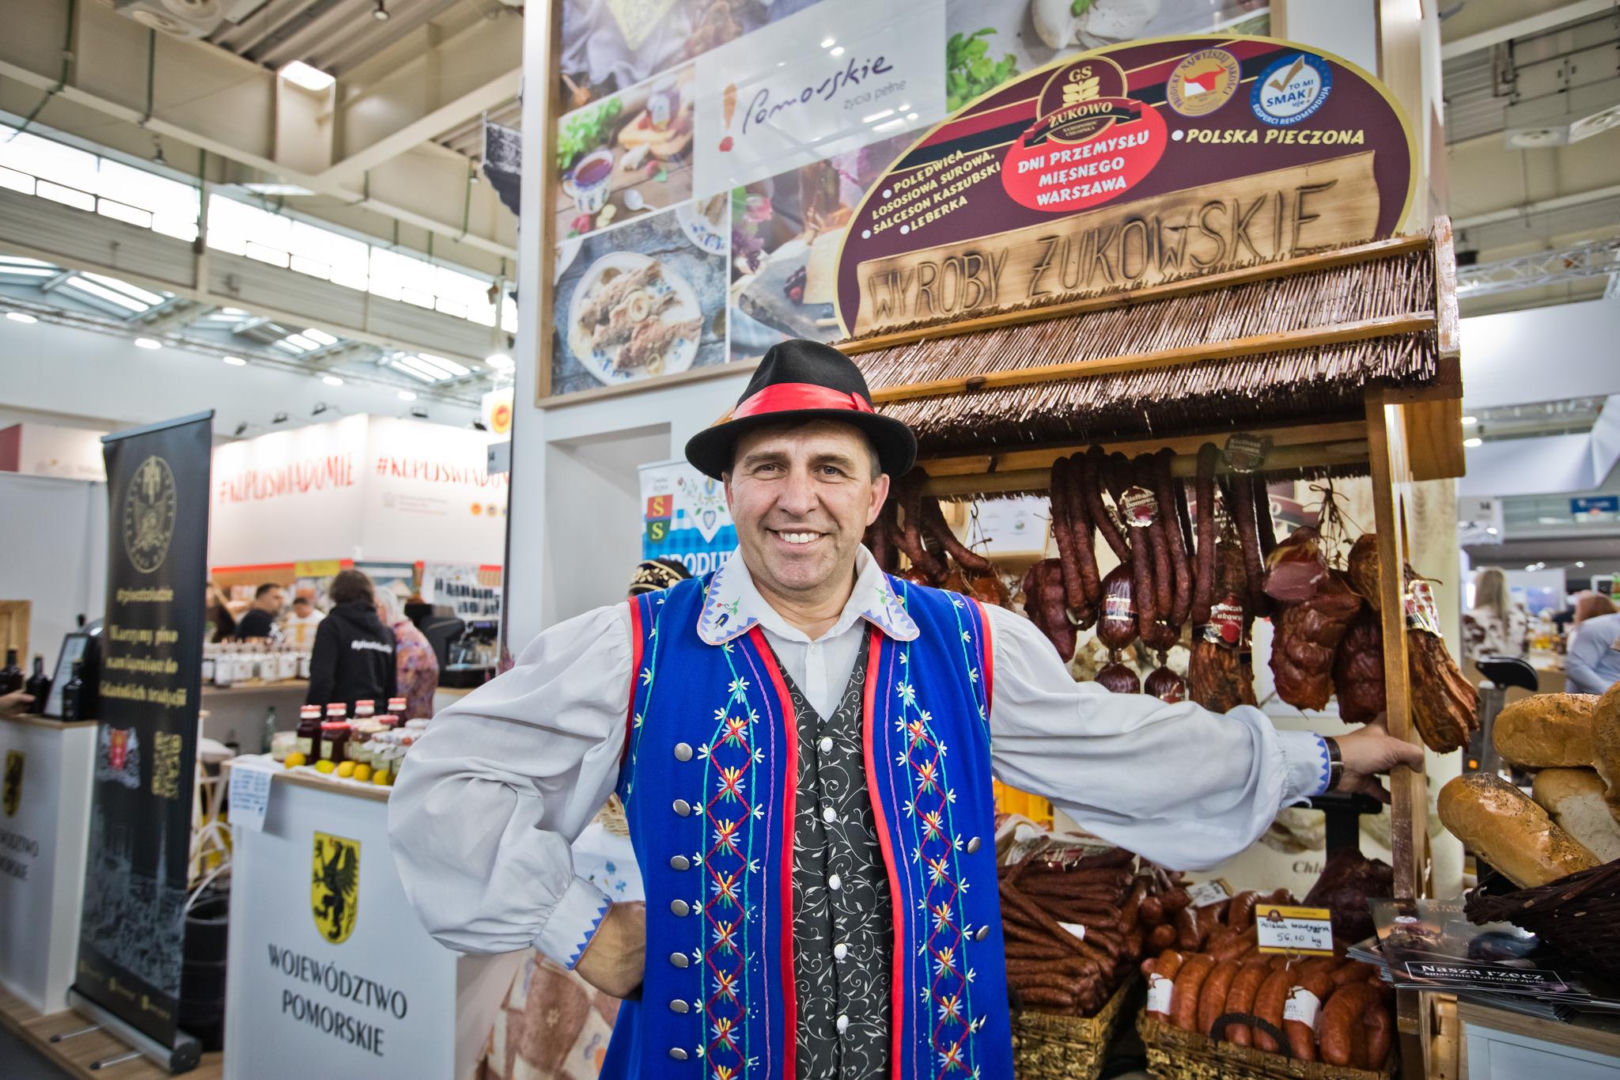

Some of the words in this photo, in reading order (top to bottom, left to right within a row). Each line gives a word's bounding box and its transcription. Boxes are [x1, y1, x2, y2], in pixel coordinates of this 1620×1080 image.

[1068, 66, 1092, 82] GS
[1302, 79, 1315, 87] MI
[742, 56, 893, 134] Pomorskie
[1048, 102, 1113, 128] ŻUKOWO
[1018, 155, 1044, 173] DNI
[1050, 130, 1149, 166] PRZEMYSŁU
[1186, 129, 1258, 144] POLSKA
[1264, 130, 1364, 144] PIECZONA
[894, 149, 965, 193] POLĘDWICA
[1039, 157, 1125, 187] MIĘSNEGO
[872, 179, 938, 220] ŁOSOSIOWA
[873, 198, 931, 235] SALCESON
[933, 161, 1001, 204] KASZUBSKI
[1036, 176, 1126, 206] WARSZAWA
[911, 195, 968, 231] LEBERKA
[868, 248, 1009, 322] WYROBY
[1026, 179, 1340, 302] ŻUKOWSKIE
[268, 943, 408, 1020] WOJEWÓDZTWO
[1422, 965, 1480, 976] Nasza
[1487, 970, 1545, 981] rzecz
[282, 989, 385, 1058] POMORSKIE
